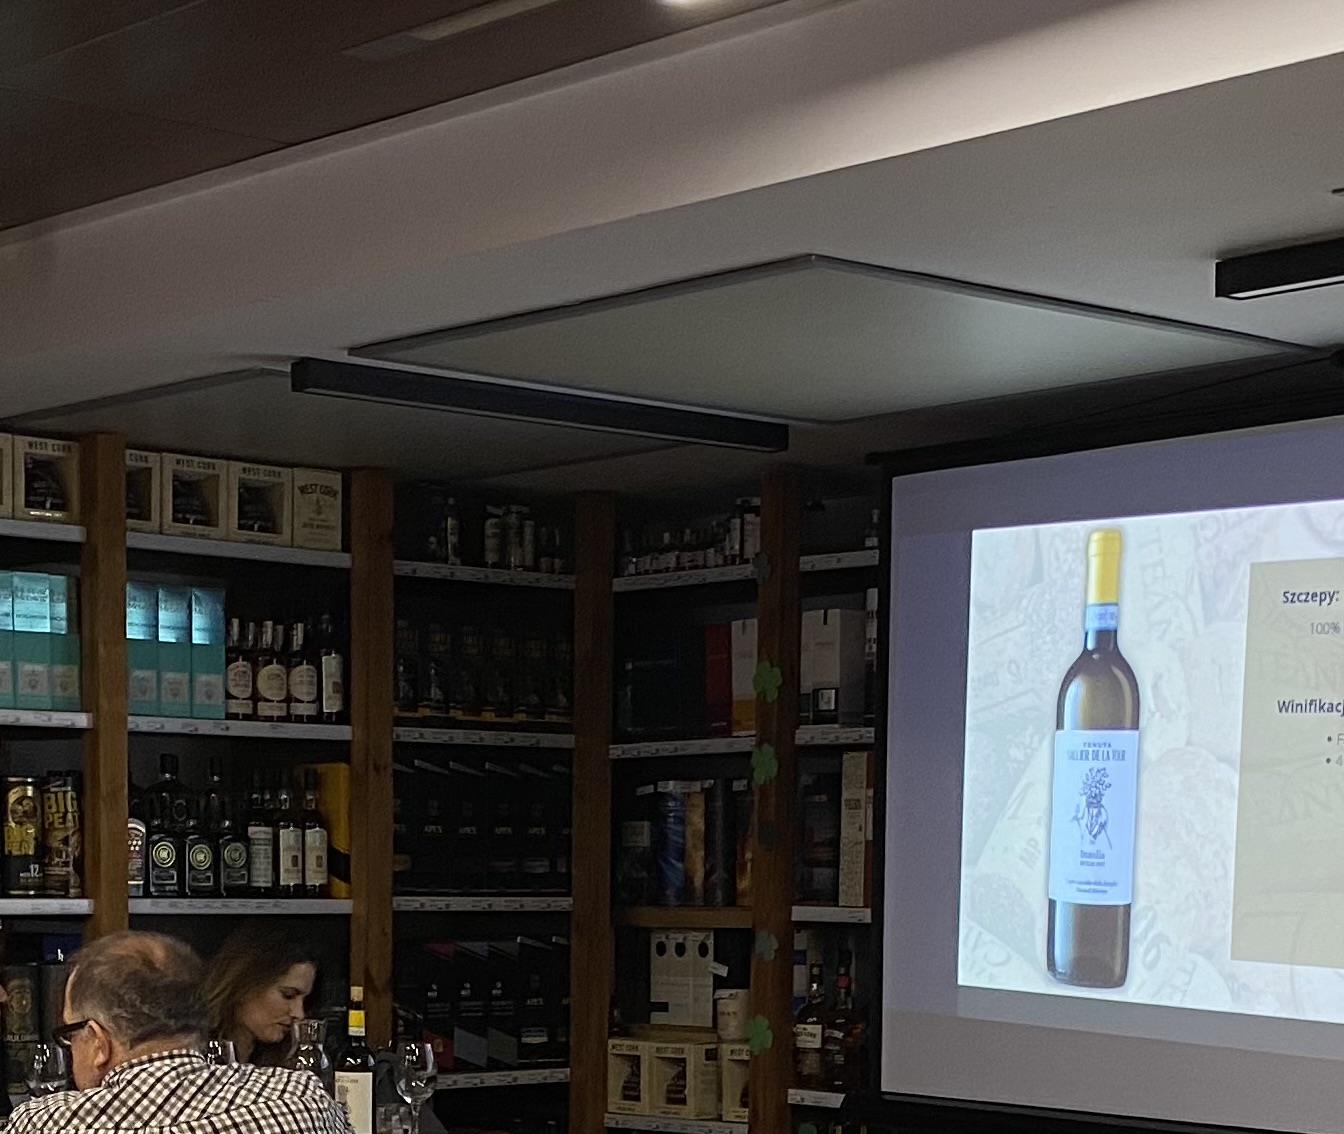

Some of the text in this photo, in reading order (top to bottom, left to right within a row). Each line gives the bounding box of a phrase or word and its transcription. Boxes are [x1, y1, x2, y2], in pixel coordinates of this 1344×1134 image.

[27, 441, 72, 453] WEST CORK
[297, 483, 318, 495] WEST
[1282, 589, 1340, 607] Szczepy:
[1309, 621, 1341, 635] 100%
[1335, 756, 1344, 768] 4
[43, 791, 78, 813] BIG
[43, 812, 80, 829] PEAT
